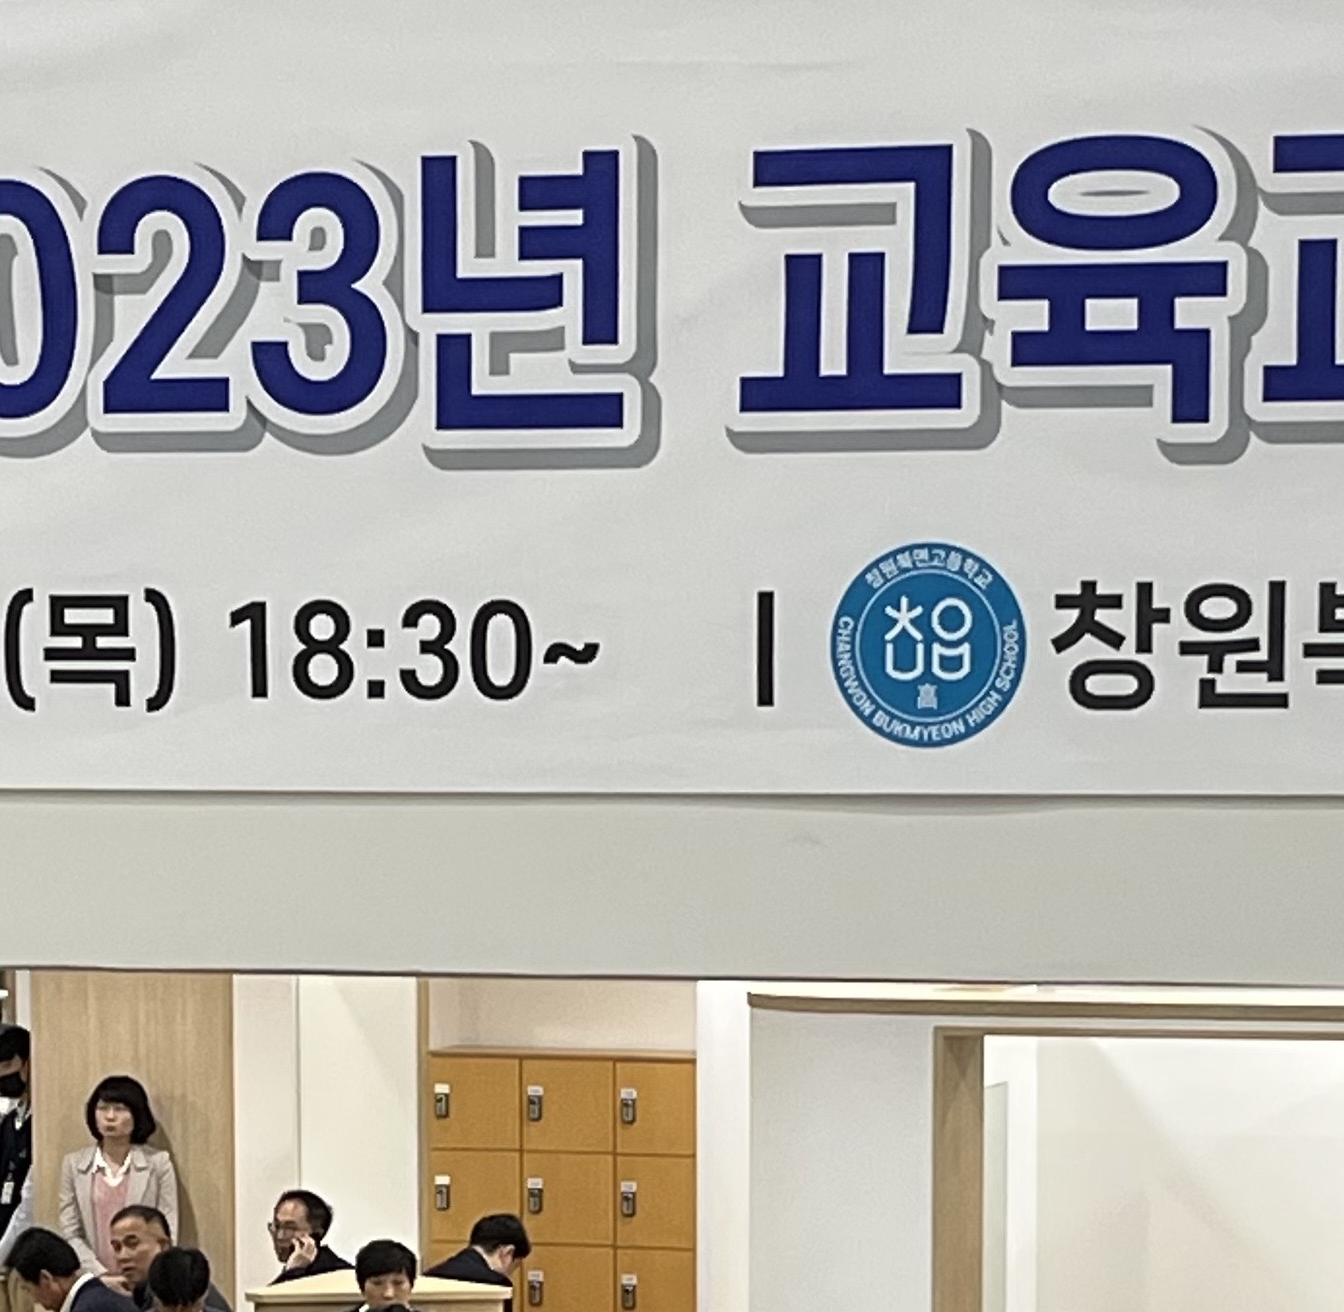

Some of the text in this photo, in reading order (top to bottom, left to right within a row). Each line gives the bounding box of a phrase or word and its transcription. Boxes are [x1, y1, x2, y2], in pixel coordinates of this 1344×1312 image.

[229, 598, 601, 703] 18:30~
[836, 616, 874, 717] CHANGWON
[965, 692, 1003, 727] HIGH
[996, 619, 1018, 692] SCHOOL
